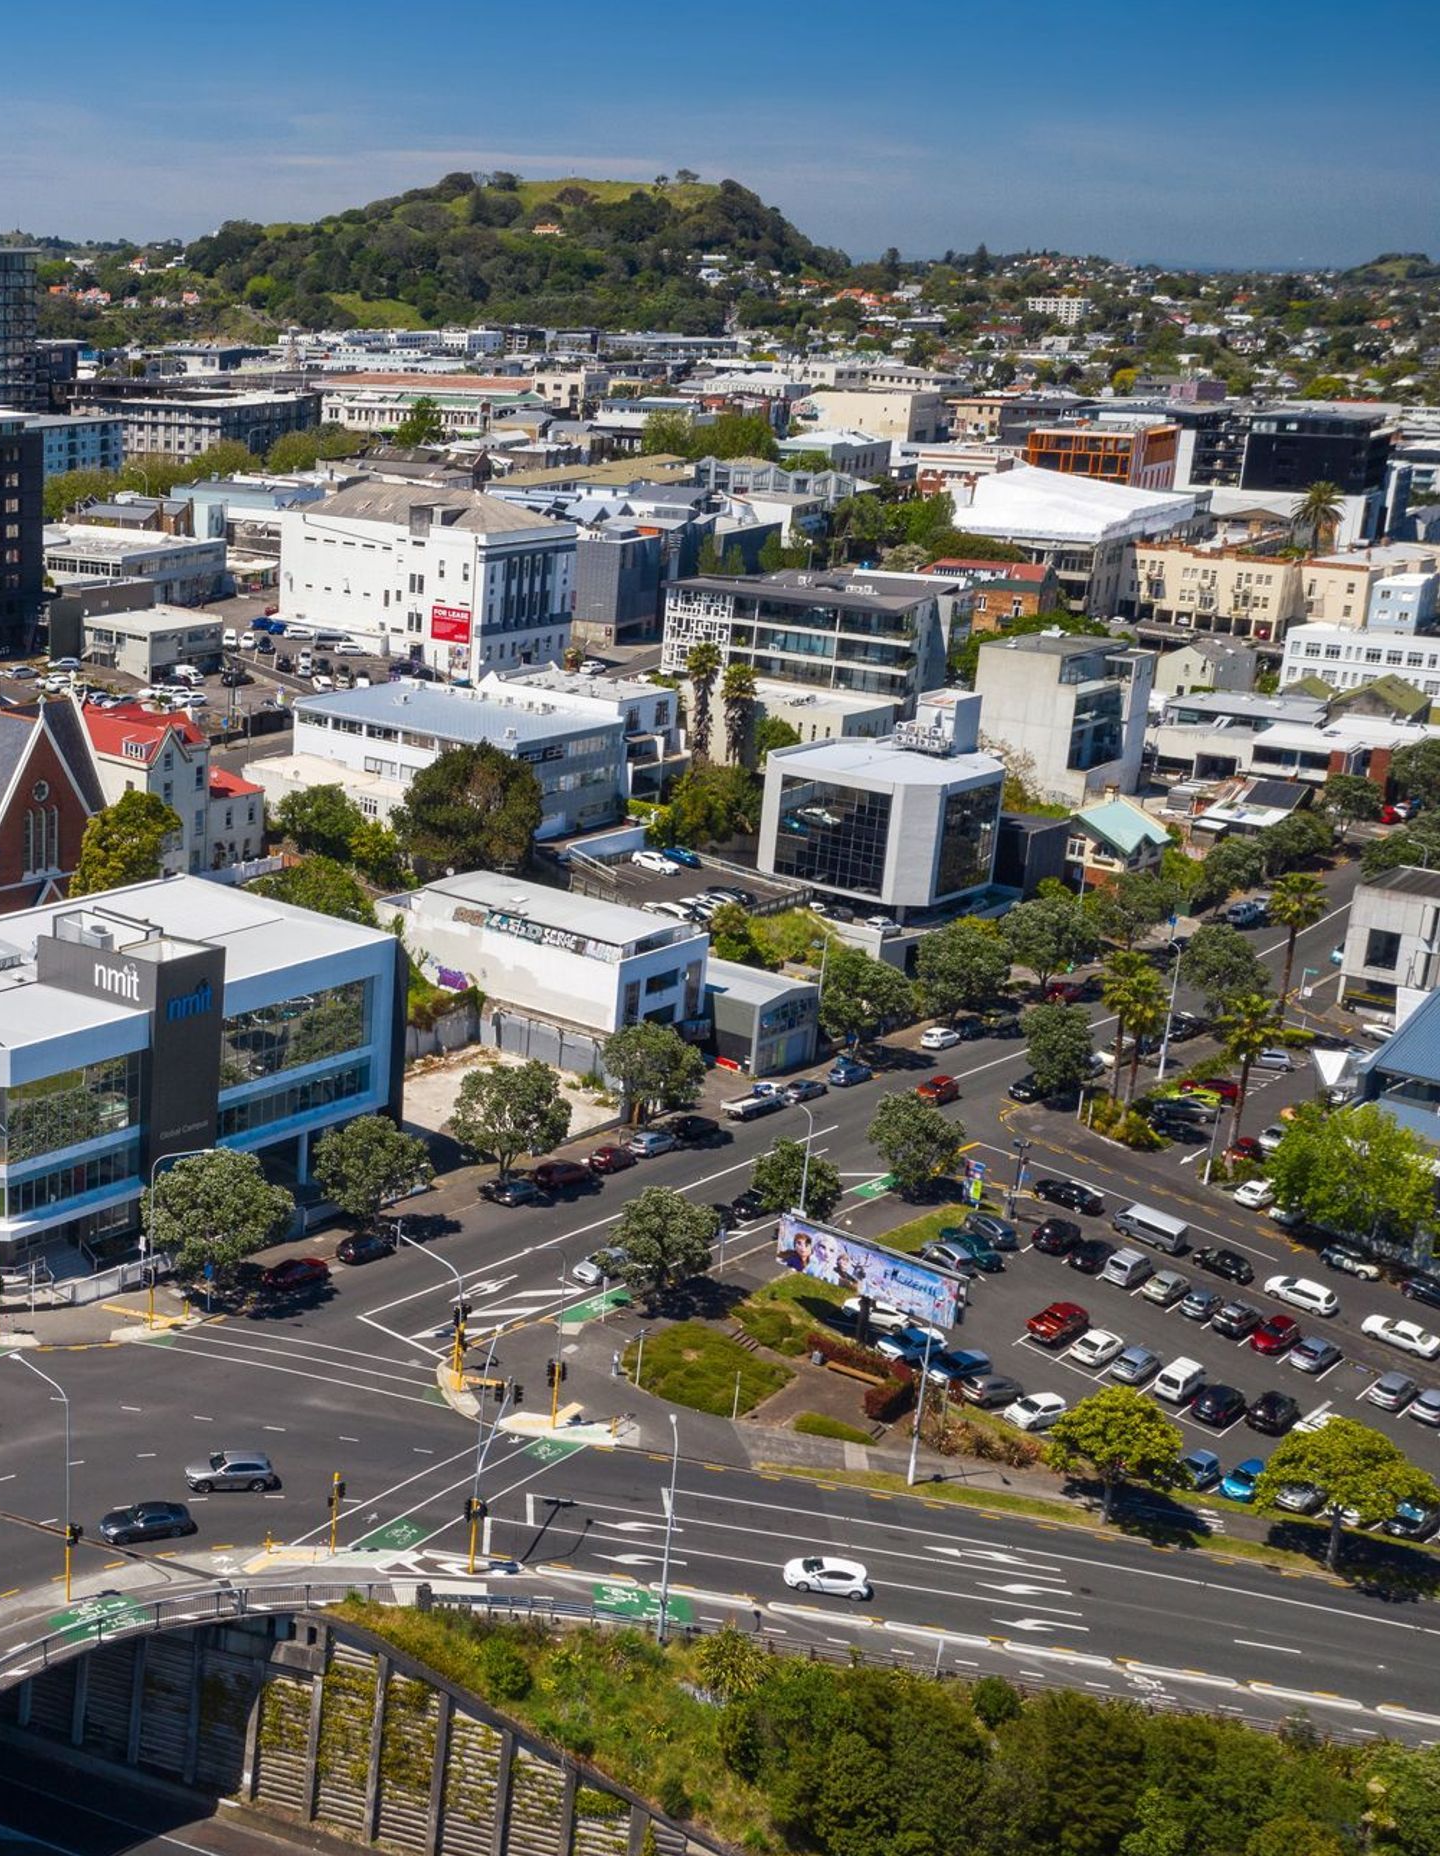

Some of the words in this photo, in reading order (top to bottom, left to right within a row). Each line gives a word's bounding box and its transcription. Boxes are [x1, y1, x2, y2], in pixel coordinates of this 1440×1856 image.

[433, 608, 447, 617] FOR
[448, 610, 469, 620] LEASE
[94, 962, 140, 1002] nmit
[167, 981, 213, 1023] nmit
